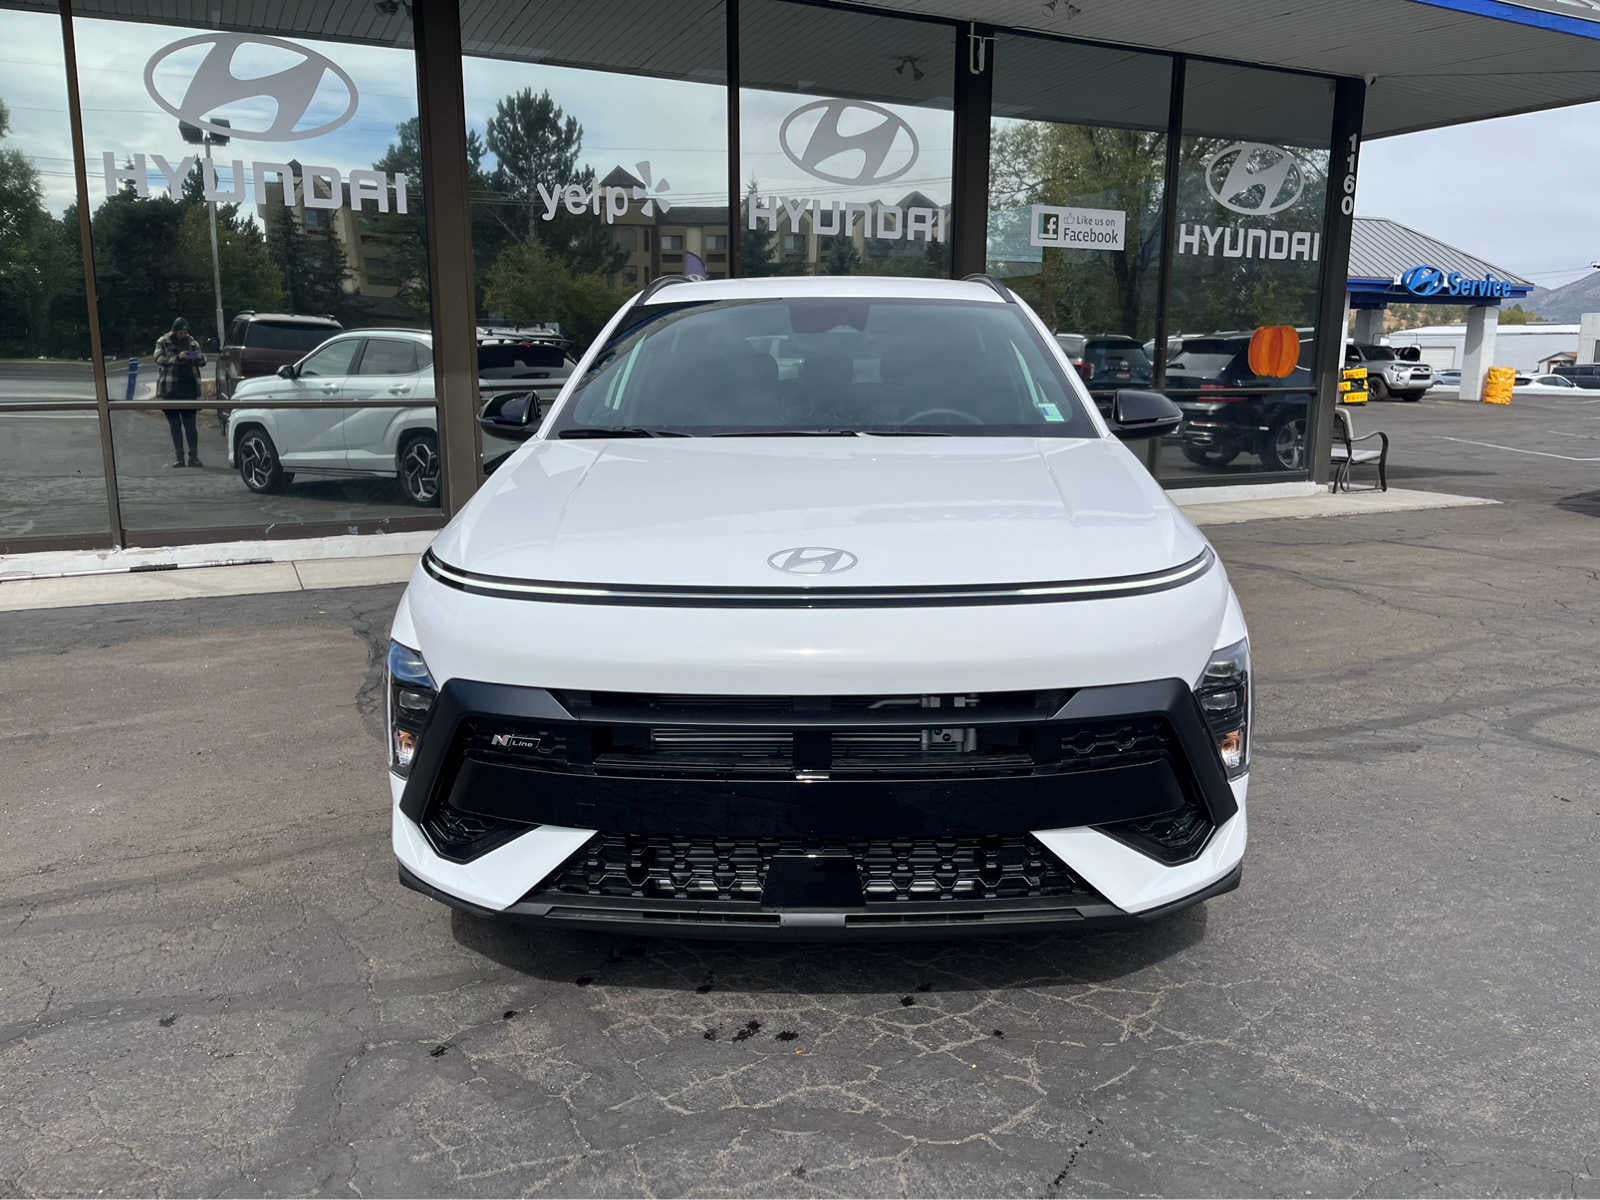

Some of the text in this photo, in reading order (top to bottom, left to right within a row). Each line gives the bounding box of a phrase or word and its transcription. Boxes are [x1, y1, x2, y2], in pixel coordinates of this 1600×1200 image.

[102, 151, 408, 215] HYUNDAI
[1341, 133, 1358, 216] 1160
[537, 177, 629, 225] yelp
[748, 193, 946, 243] HYUNDAI
[1076, 215, 1116, 227] Like us on
[1063, 227, 1119, 244] Facebook
[1178, 222, 1320, 262] HYUNDAI
[1448, 271, 1512, 298] Service
